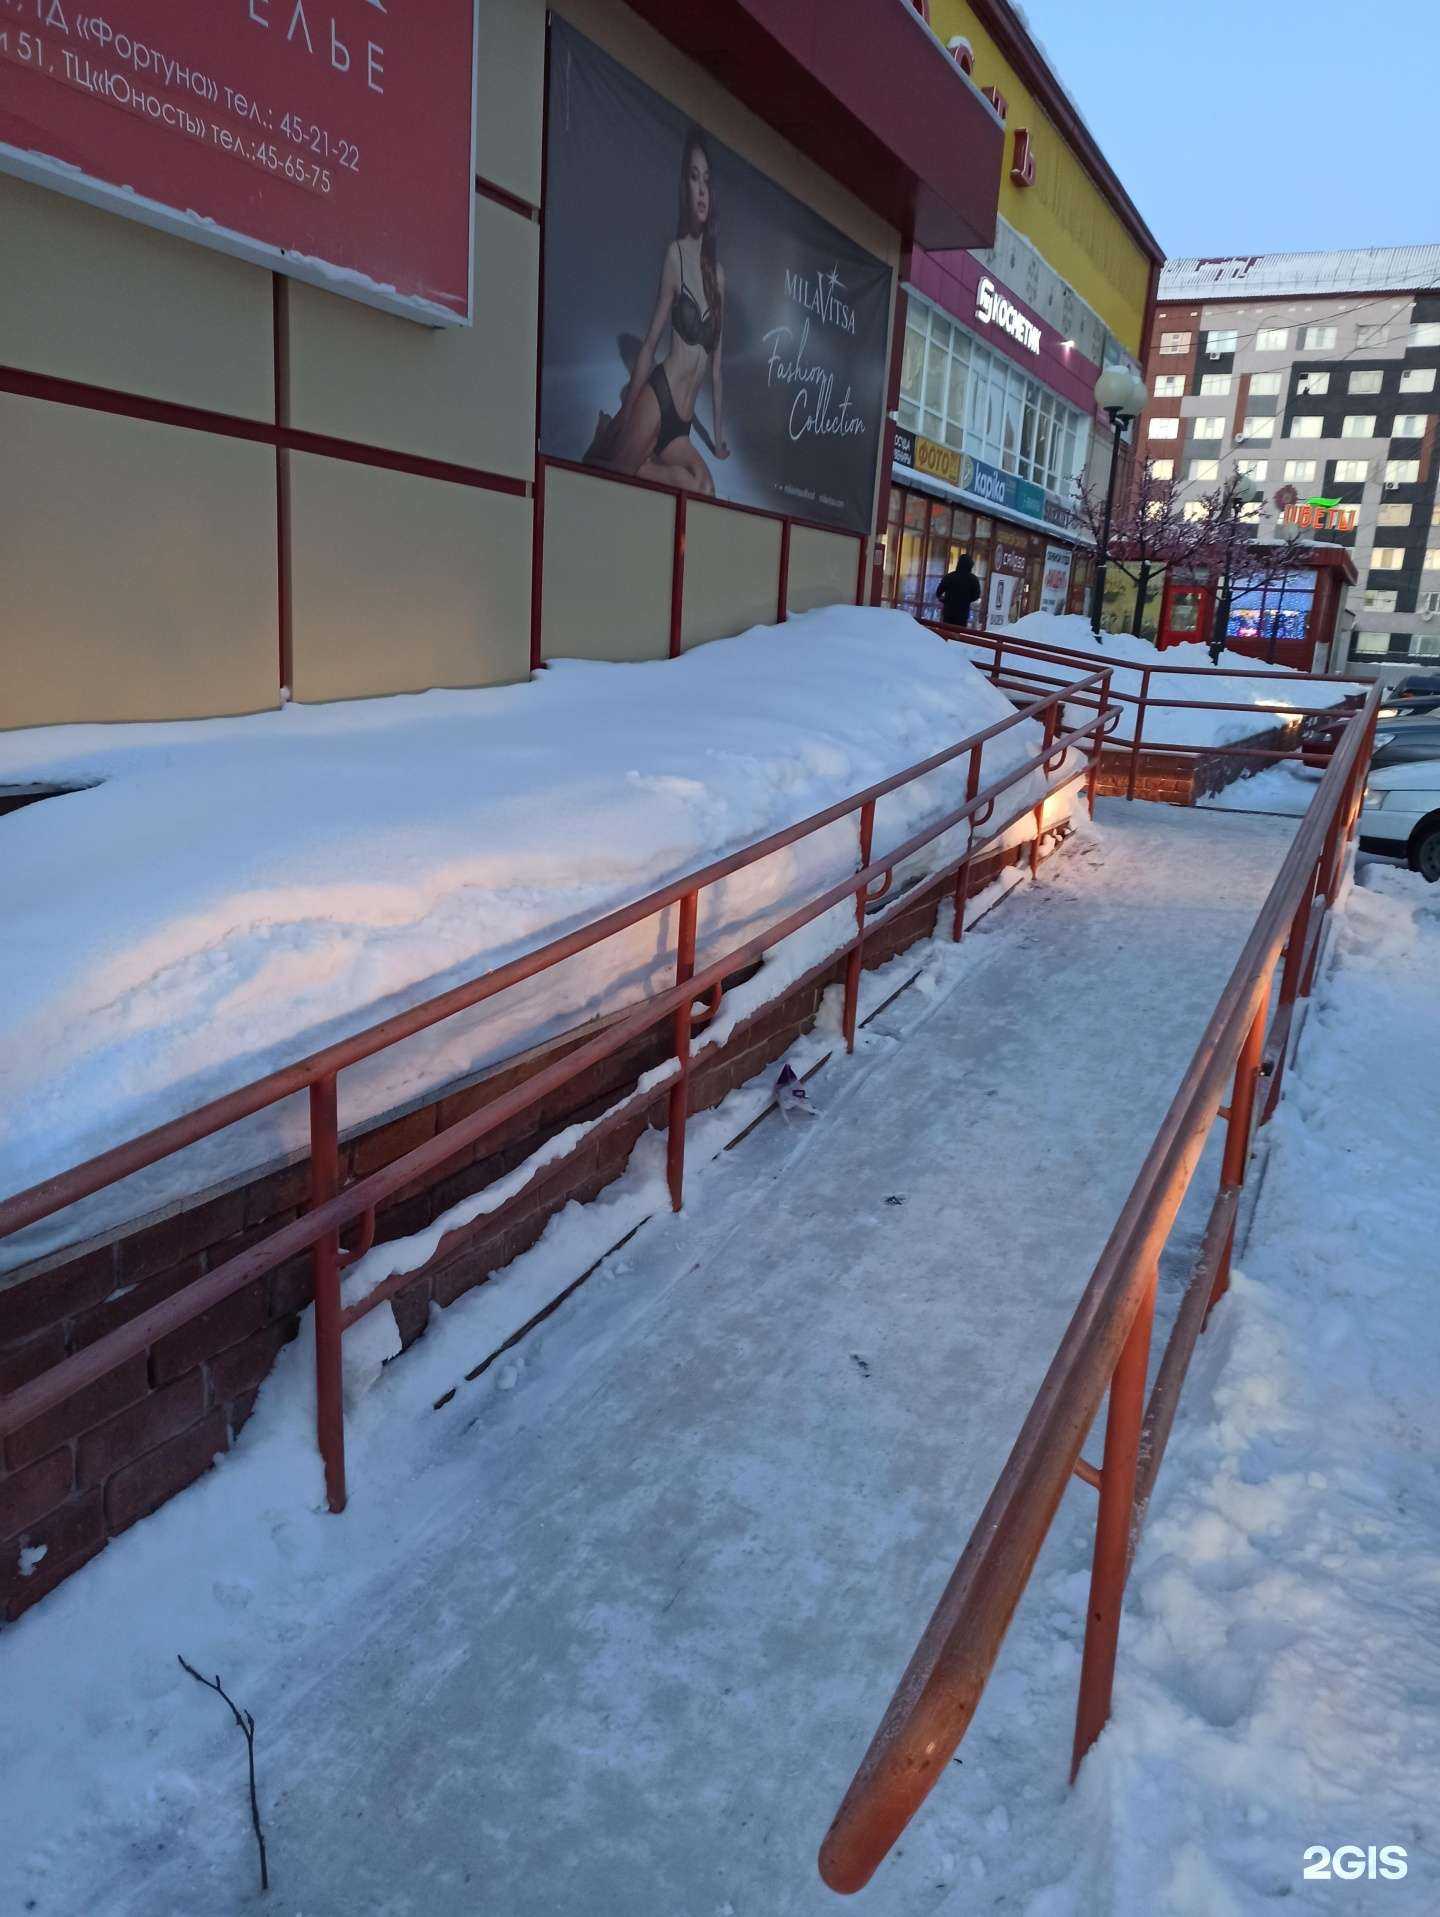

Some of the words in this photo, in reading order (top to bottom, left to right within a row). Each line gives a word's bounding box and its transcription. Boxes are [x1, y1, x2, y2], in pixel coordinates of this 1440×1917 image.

[76, 14, 218, 102] «Фортуна»
[223, 86, 273, 130] тел.:
[280, 112, 360, 172] 45-21-22
[762, 317, 828, 388] Fashion
[788, 372, 866, 441] Collection
[974, 462, 1006, 503] kapika
[1284, 503, 1357, 531] ЦВЕТЫ
